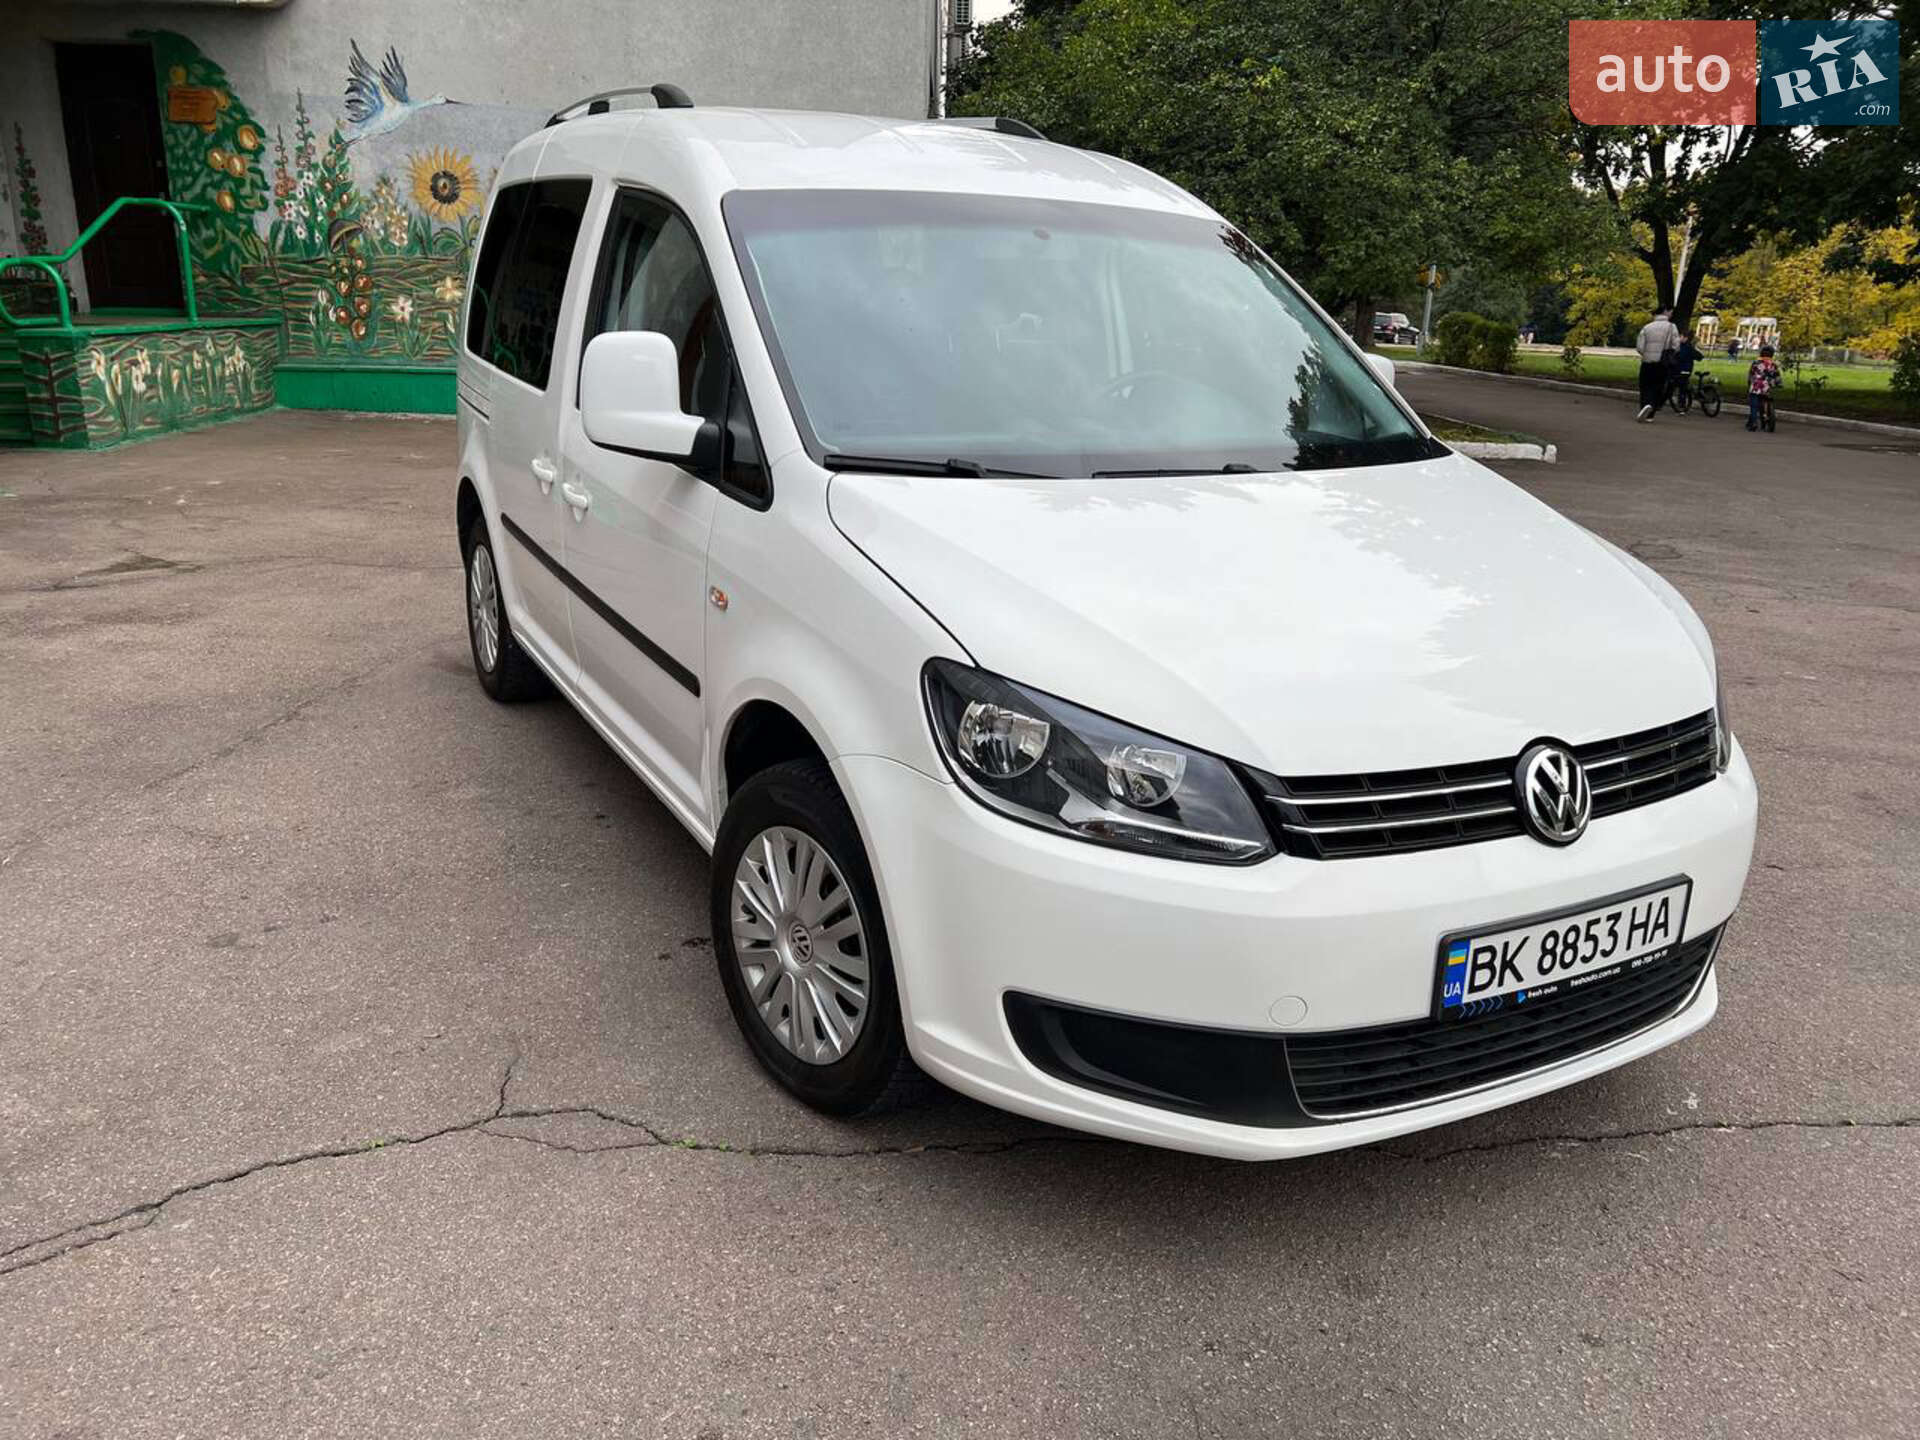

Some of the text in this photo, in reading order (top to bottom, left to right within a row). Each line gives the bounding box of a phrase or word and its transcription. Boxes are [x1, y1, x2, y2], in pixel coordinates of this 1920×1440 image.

[1467, 897, 1670, 994] BK 8853 HA
[1443, 983, 1462, 998] UA
